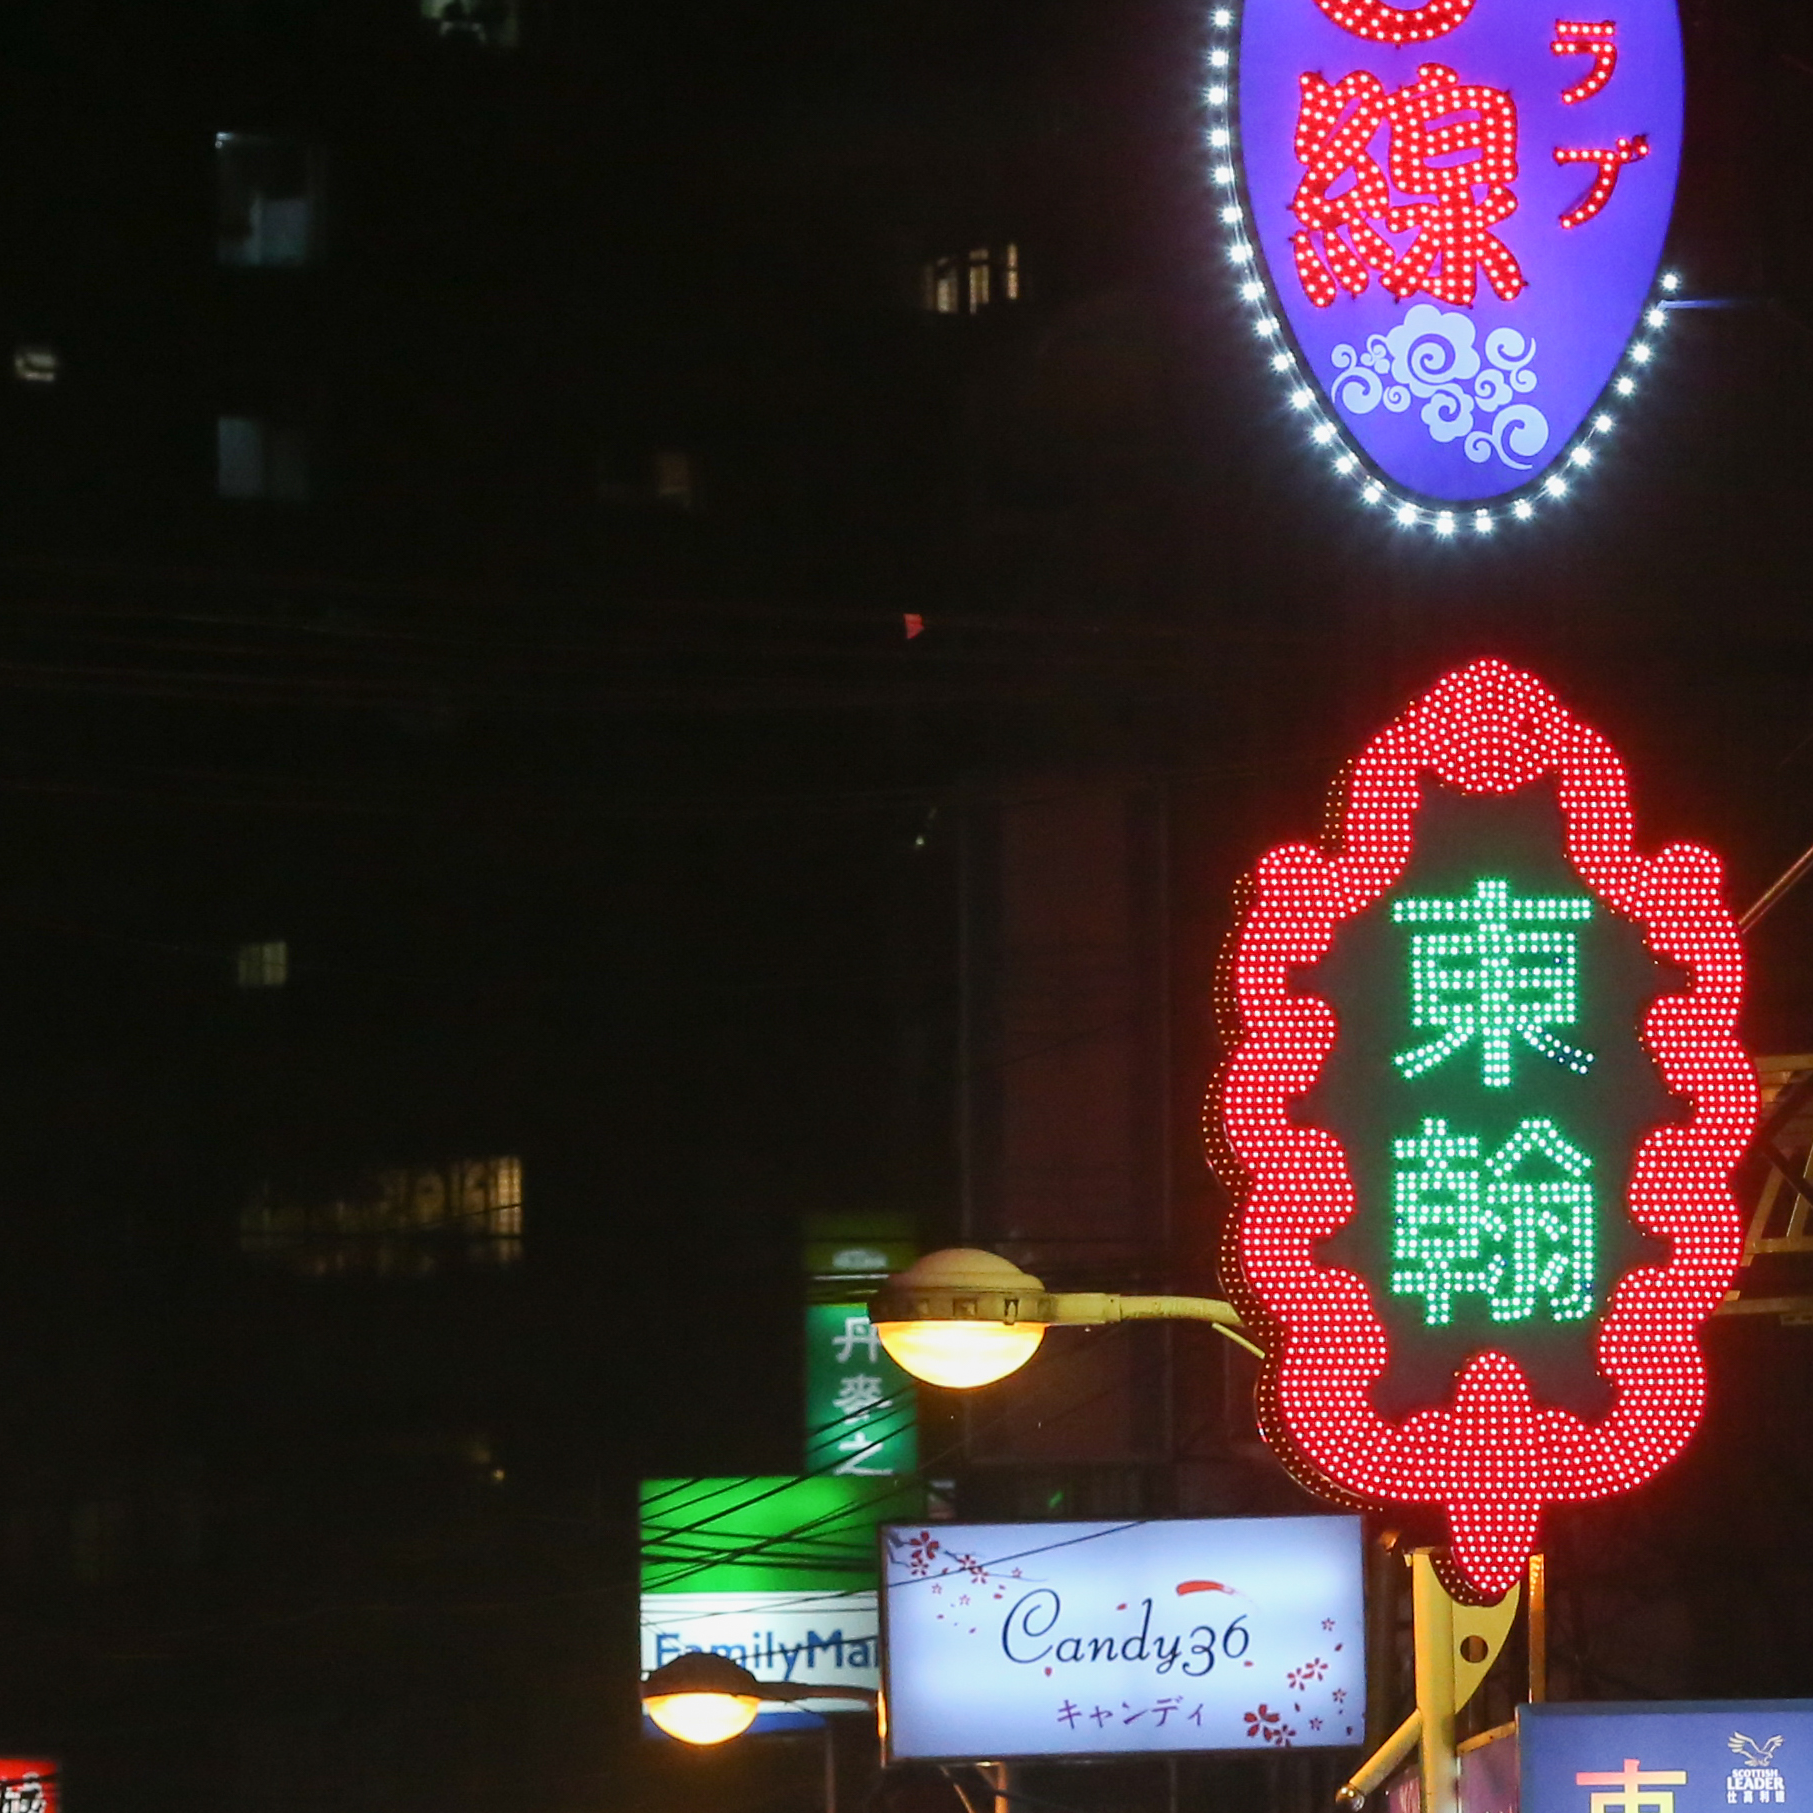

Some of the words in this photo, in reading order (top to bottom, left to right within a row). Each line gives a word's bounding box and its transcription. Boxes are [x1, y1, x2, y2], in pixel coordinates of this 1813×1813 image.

[1001, 1588, 1251, 1676] Candy36
[1056, 1695, 1205, 1729] キャンディ
[1726, 1776, 1785, 1790] LEADER
[1731, 1768, 1779, 1778] SCOTTISH
